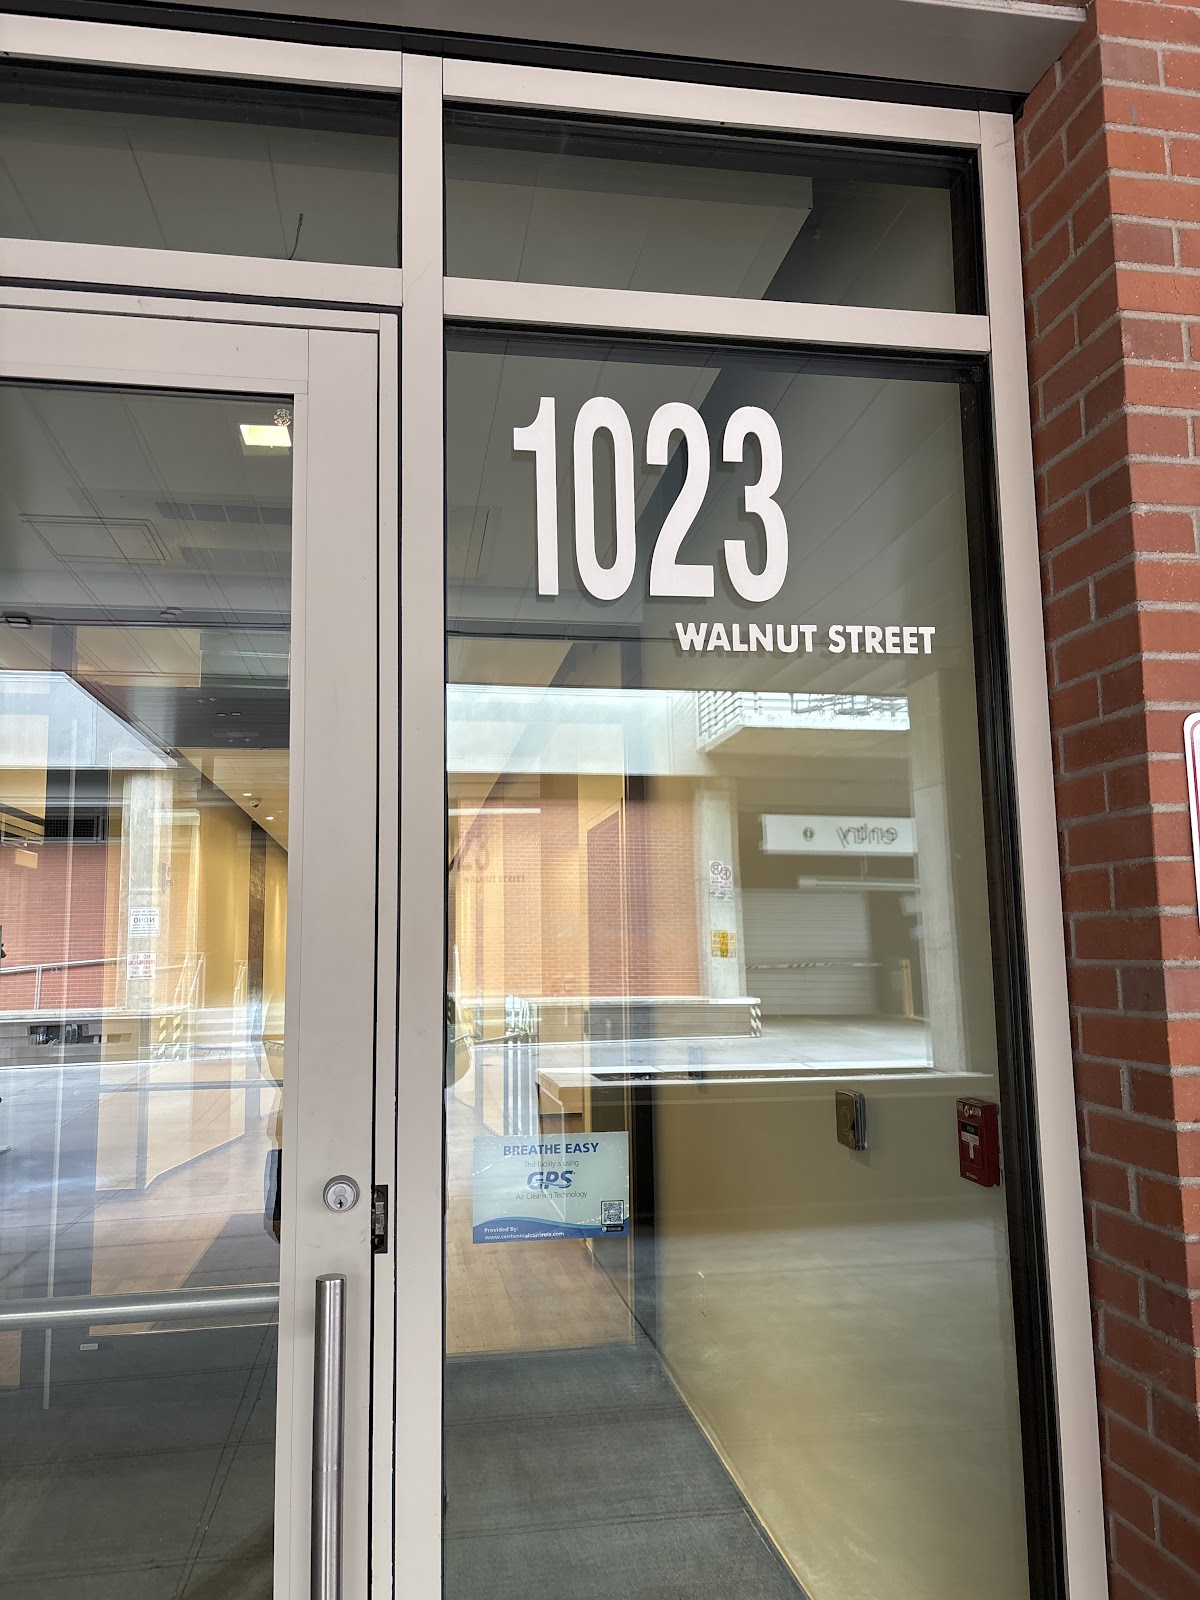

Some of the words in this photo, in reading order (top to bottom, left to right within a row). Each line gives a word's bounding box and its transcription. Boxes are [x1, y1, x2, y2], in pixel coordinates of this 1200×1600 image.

[513, 396, 789, 602] 1023
[675, 622, 817, 653] WALNUT
[828, 624, 936, 655] STREET
[503, 1143, 561, 1156] BREATHE
[565, 1142, 600, 1154] EASY
[563, 1159, 580, 1168] using
[526, 1170, 574, 1191] GPS
[526, 1191, 553, 1201] Cleaning
[553, 1190, 588, 1200] Technology
